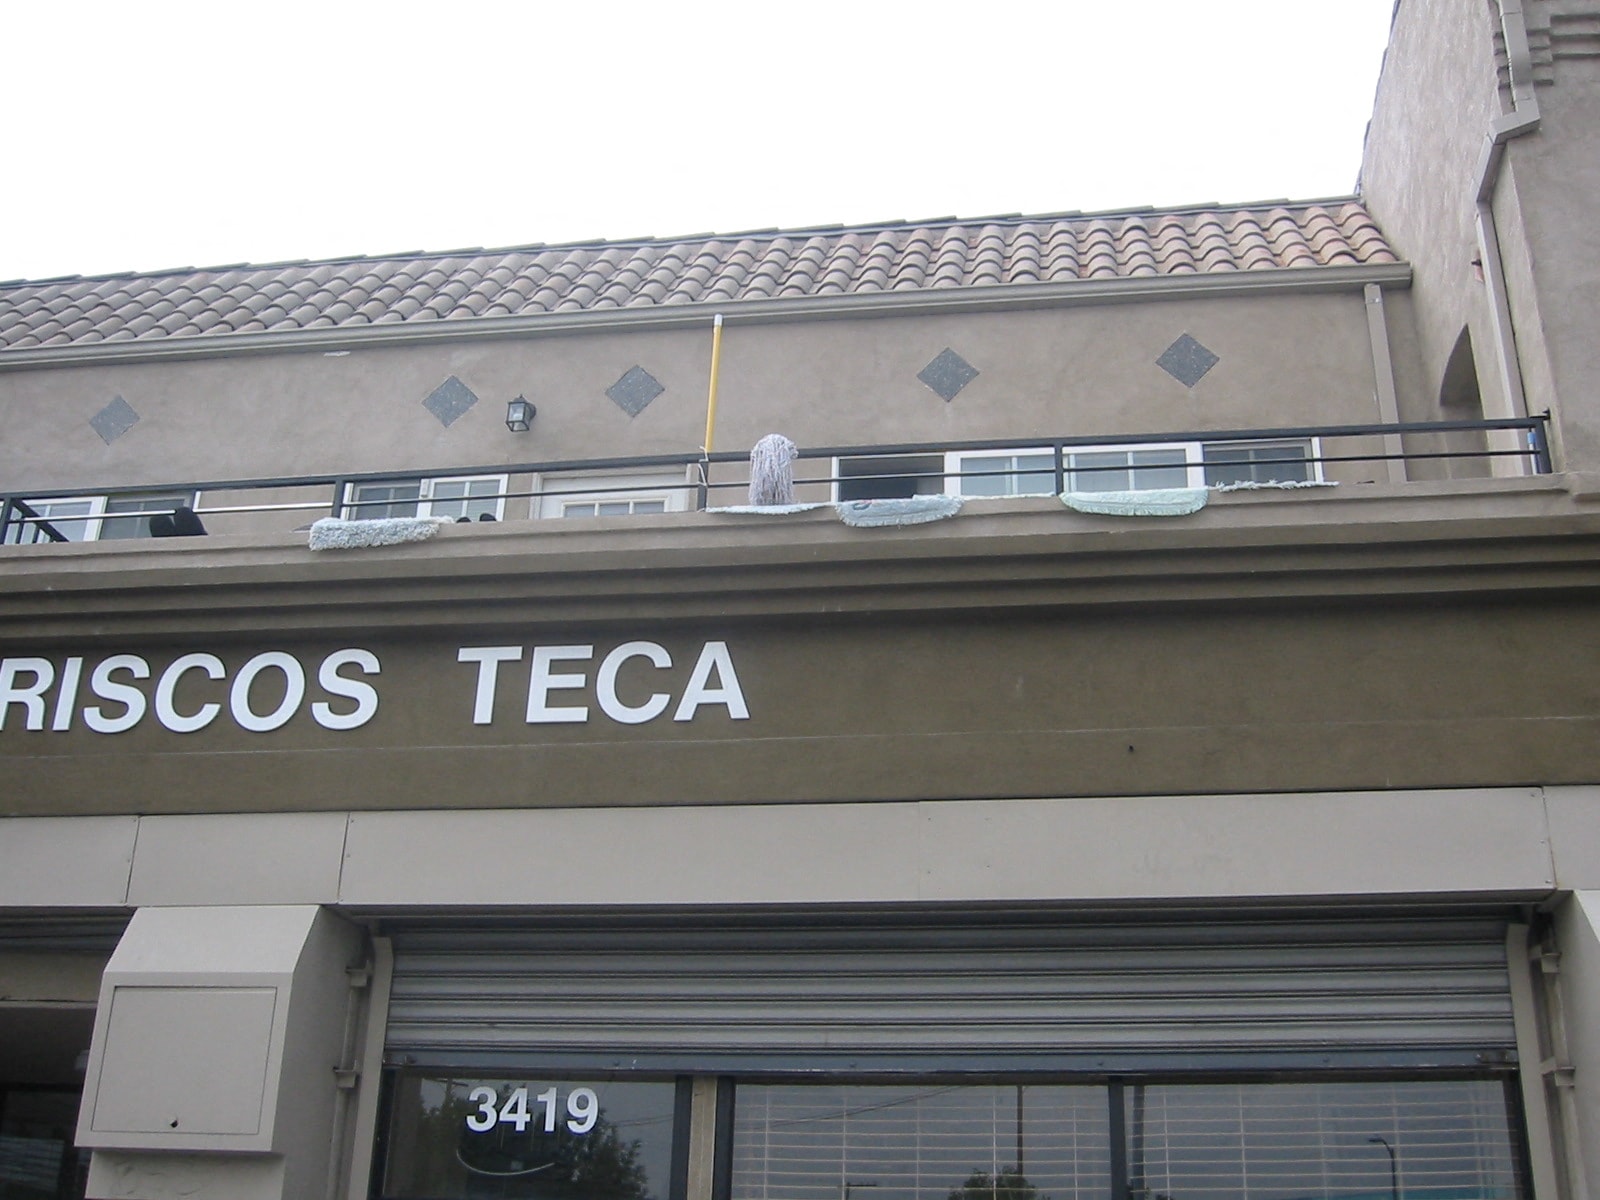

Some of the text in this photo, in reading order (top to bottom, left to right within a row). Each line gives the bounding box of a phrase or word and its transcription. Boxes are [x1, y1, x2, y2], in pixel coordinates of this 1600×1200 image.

[0, 641, 750, 733] RISCOS TECA
[466, 1086, 599, 1134] 3419
